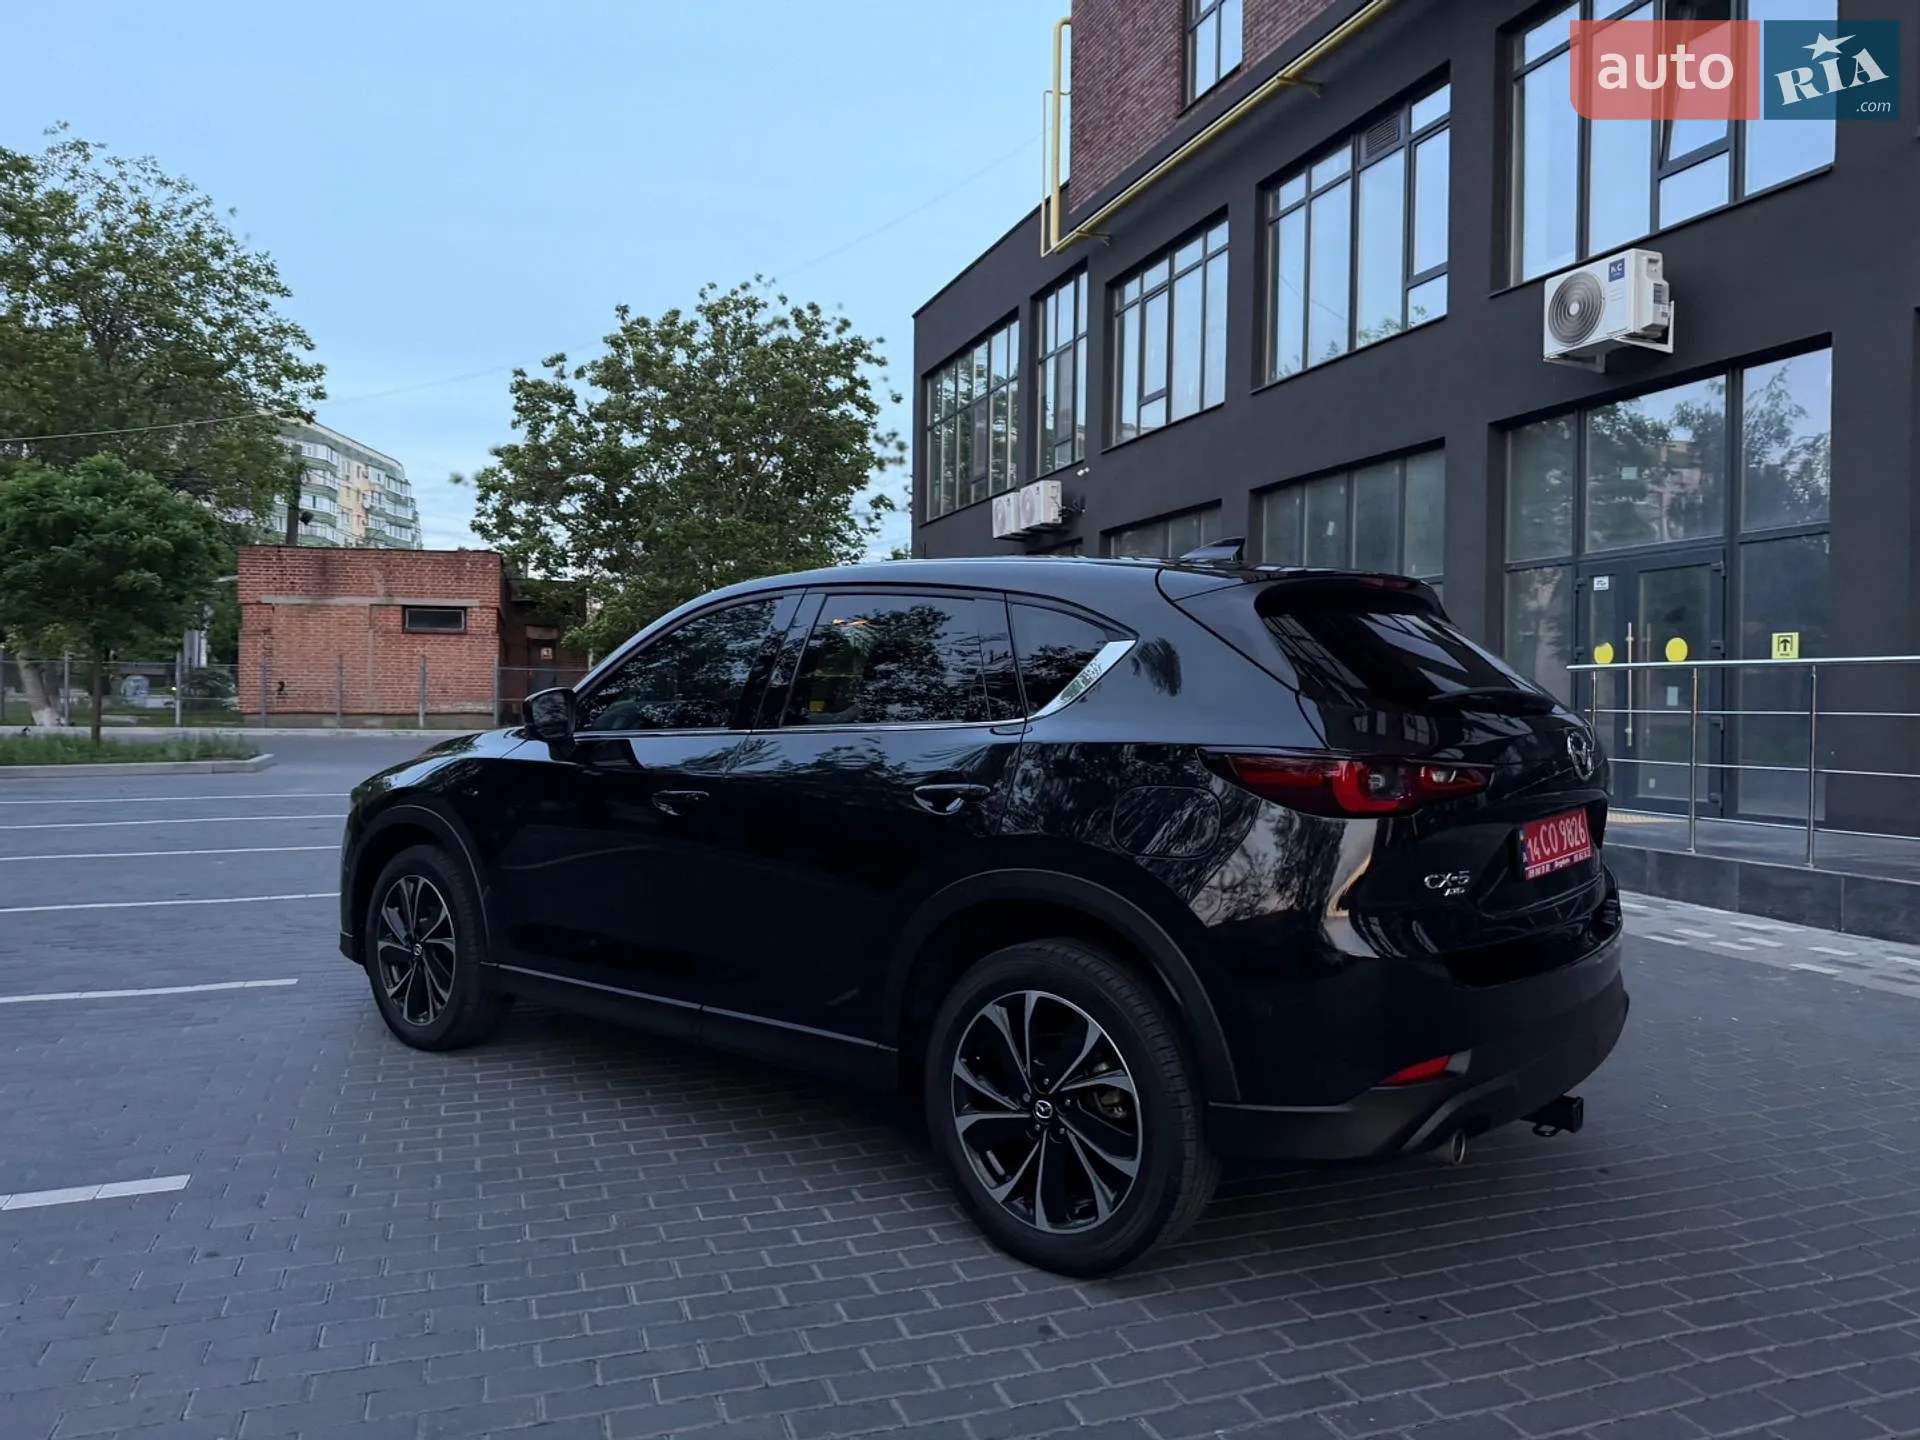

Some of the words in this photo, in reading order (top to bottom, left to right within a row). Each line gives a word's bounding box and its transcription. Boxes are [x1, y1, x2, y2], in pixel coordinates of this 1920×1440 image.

[1527, 836, 1541, 862] 14
[1540, 823, 1558, 856] CO
[1559, 813, 1586, 851] 9826
[1424, 870, 1470, 889] CX-5
